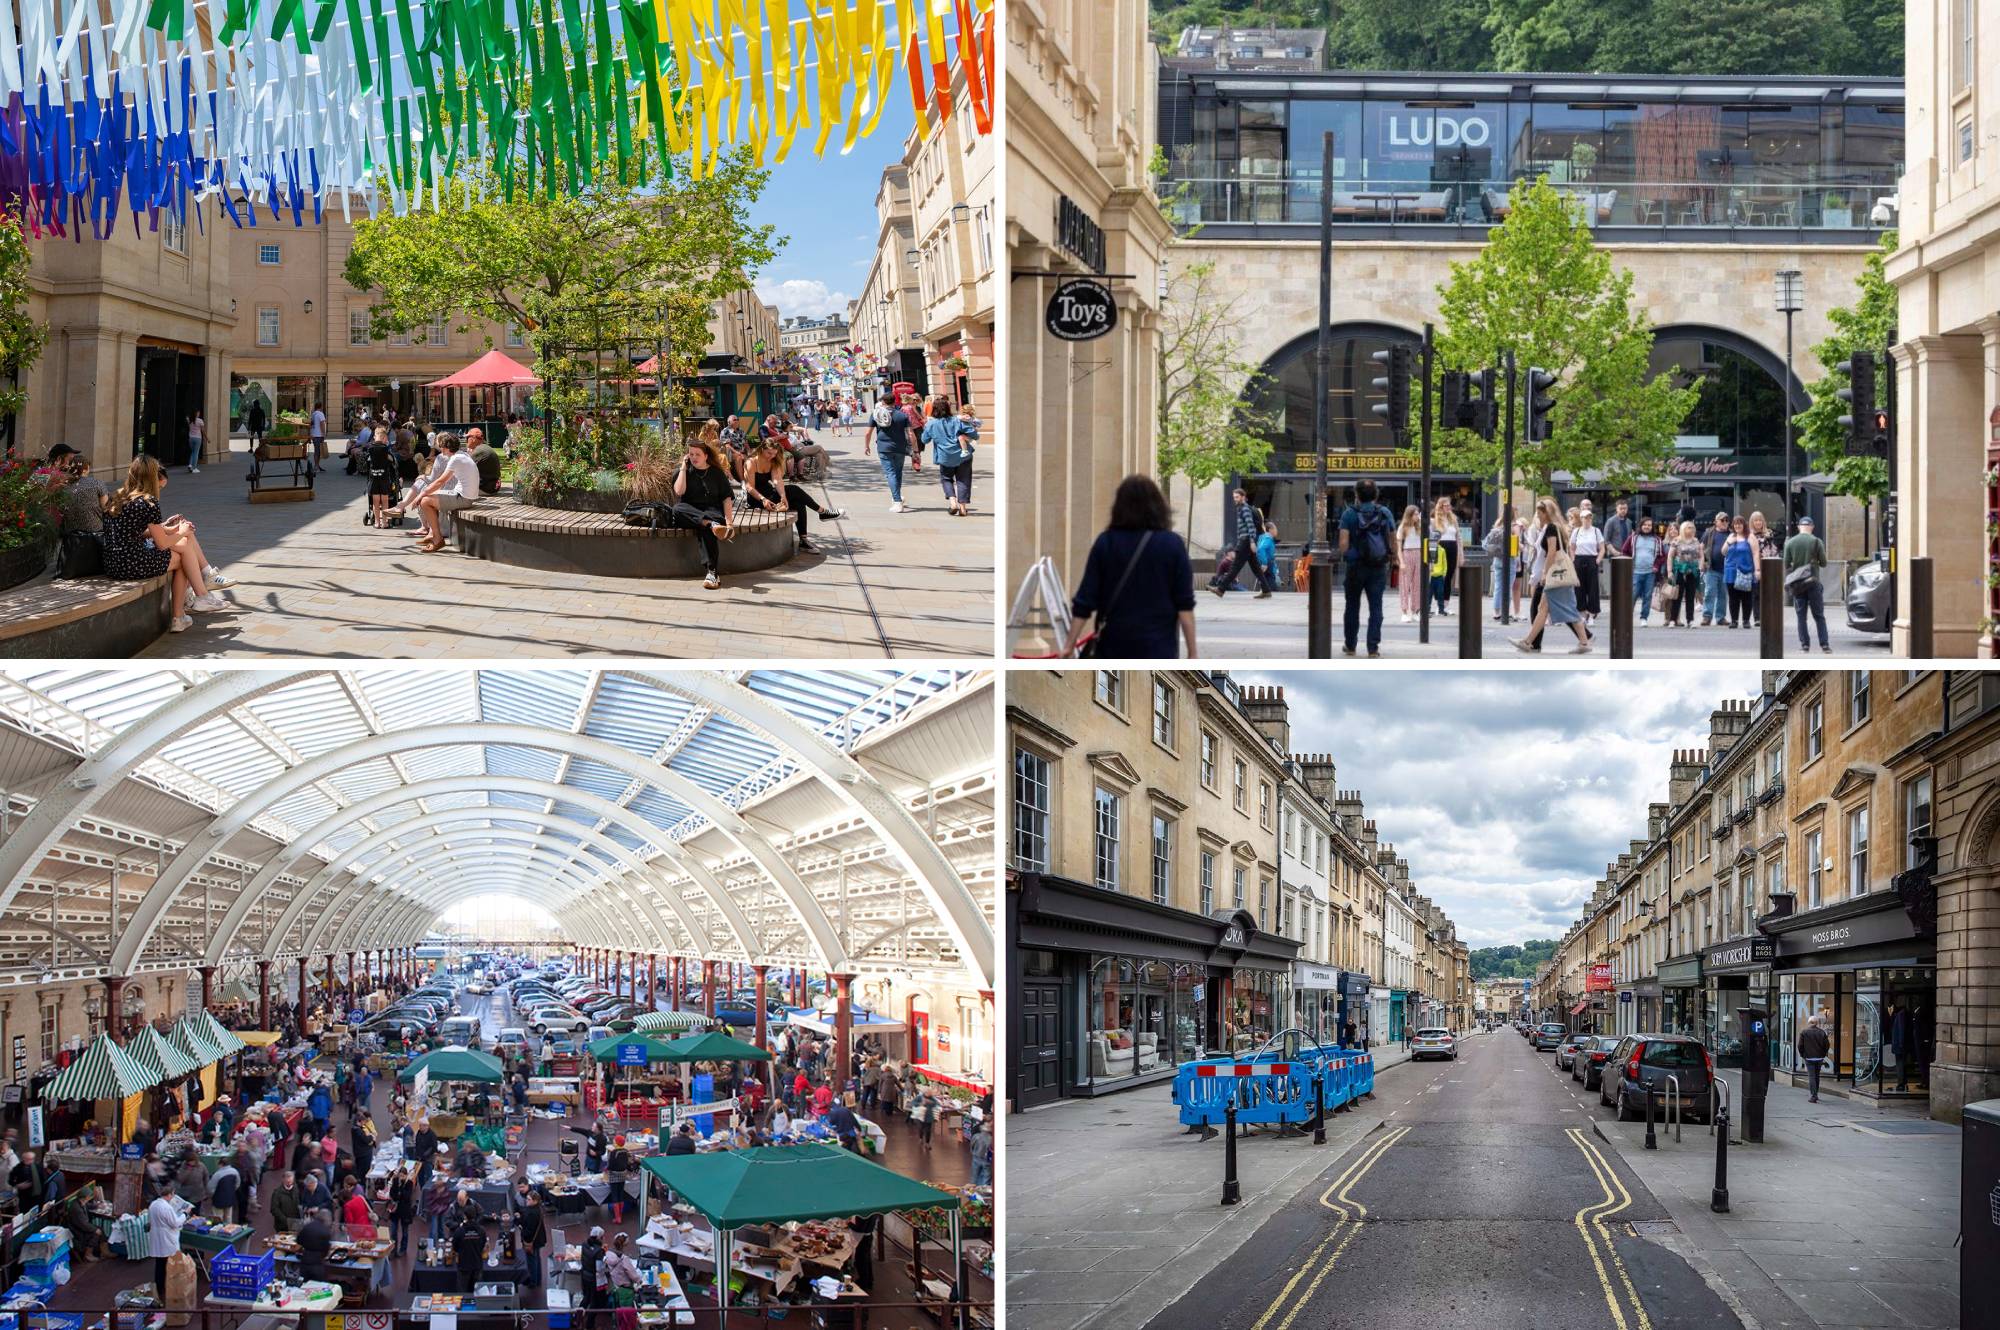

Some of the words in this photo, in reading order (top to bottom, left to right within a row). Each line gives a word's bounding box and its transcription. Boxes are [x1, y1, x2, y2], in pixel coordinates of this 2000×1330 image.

[1390, 116, 1490, 147] LUDO
[1057, 296, 1108, 327] Toys
[1296, 457, 1344, 468] GOUET
[1346, 457, 1386, 468] BURGER
[1389, 457, 1422, 468] KITCH
[1812, 931, 1830, 944] MOSS
[1830, 927, 1851, 941] BROS.
[1755, 1021, 1763, 1033] P
